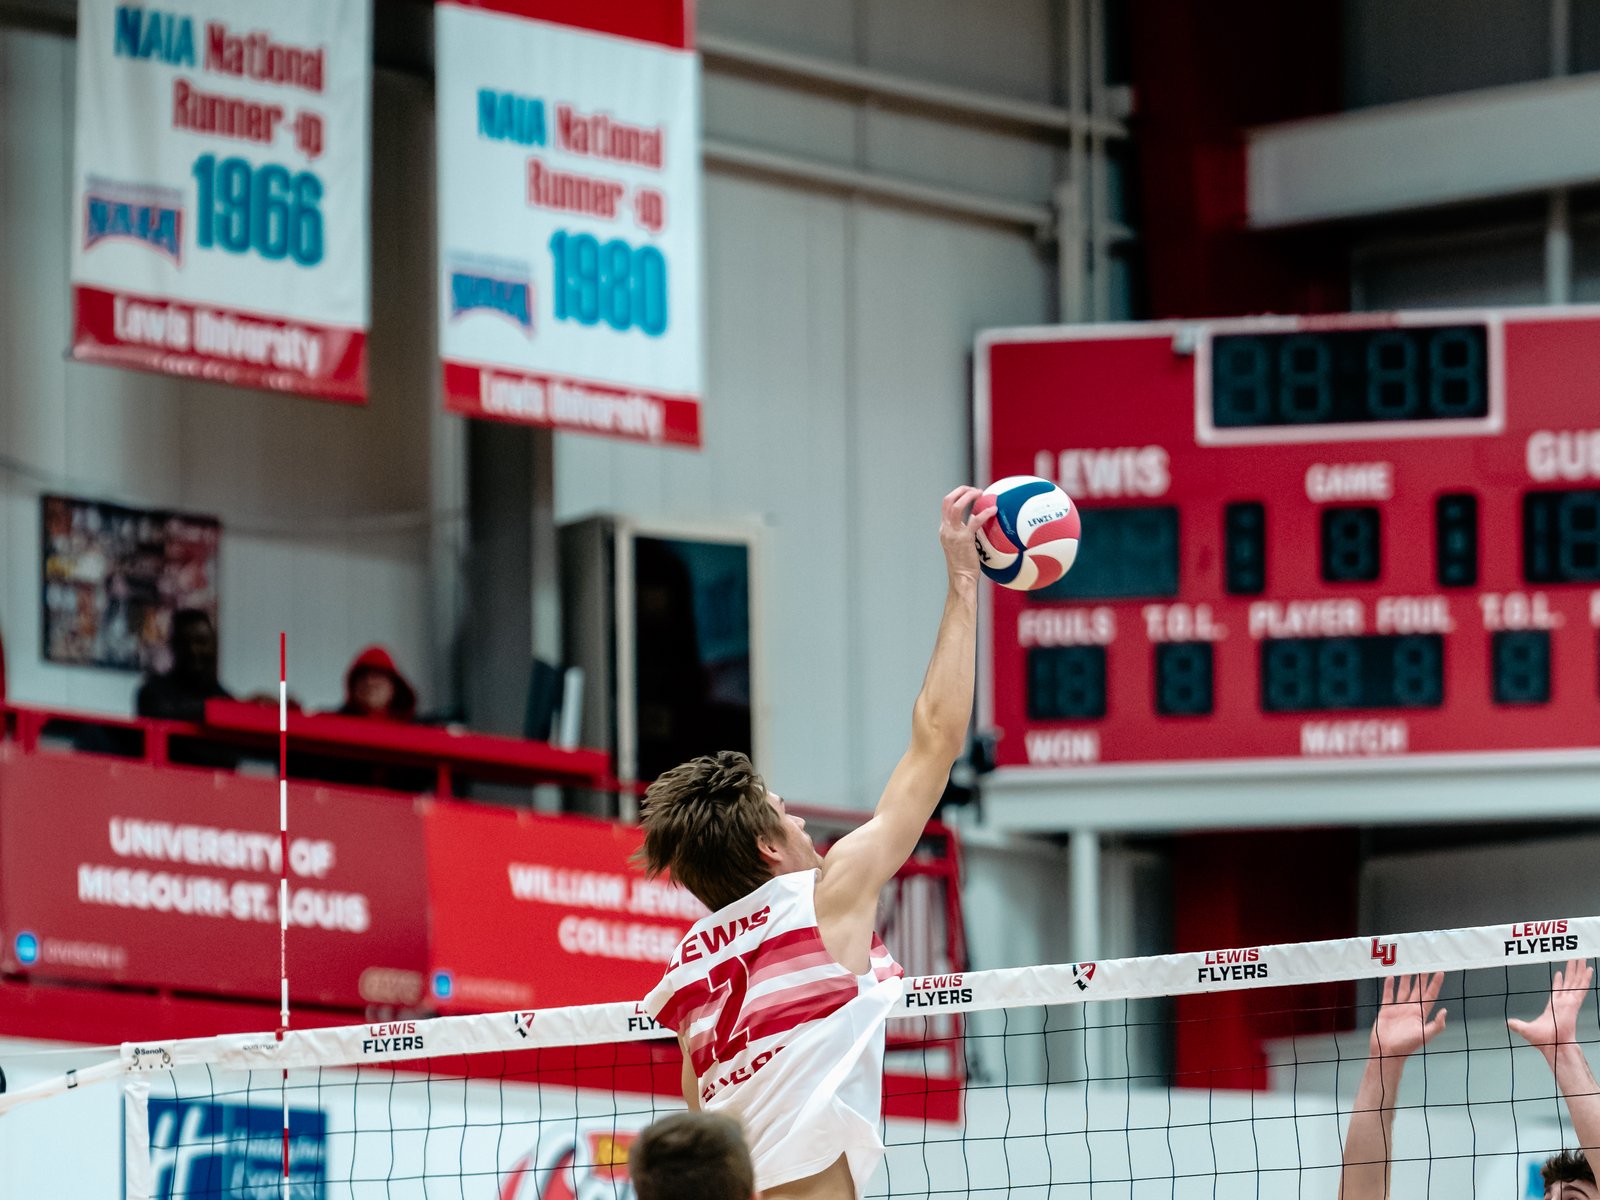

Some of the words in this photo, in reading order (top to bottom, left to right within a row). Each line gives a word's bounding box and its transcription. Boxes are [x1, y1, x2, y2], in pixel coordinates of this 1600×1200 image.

[114, 5, 196, 68] NAIA
[205, 19, 324, 94] National
[555, 102, 663, 169] National
[193, 153, 324, 267] 1966
[548, 229, 667, 337] 1980
[1034, 446, 1170, 501] LEWIS
[1305, 463, 1393, 499] GAME
[1018, 606, 1116, 648] FOULS
[1250, 601, 1366, 639] PLAYER
[1376, 596, 1454, 635] FOUL
[1025, 728, 1100, 767] WON
[1300, 719, 1407, 755] MATCH
[110, 818, 284, 873] UNIVERSITY
[290, 838, 335, 877] OF
[508, 863, 626, 911] WILLIAM
[279, 885, 370, 933] LOUIS
[1512, 920, 1568, 937] LEWIS
[558, 916, 680, 964] COLLEGE
[664, 905, 771, 976] LEWIS
[1205, 948, 1260, 965] LEWIS
[1504, 935, 1578, 956] FLYERS
[912, 974, 964, 990] LEWIS
[1198, 963, 1268, 983] FLYERS
[707, 954, 750, 1064] 2
[906, 988, 973, 1008] FLYERS
[363, 1036, 424, 1054] FLYERS
[370, 1022, 417, 1038] LEWIS
